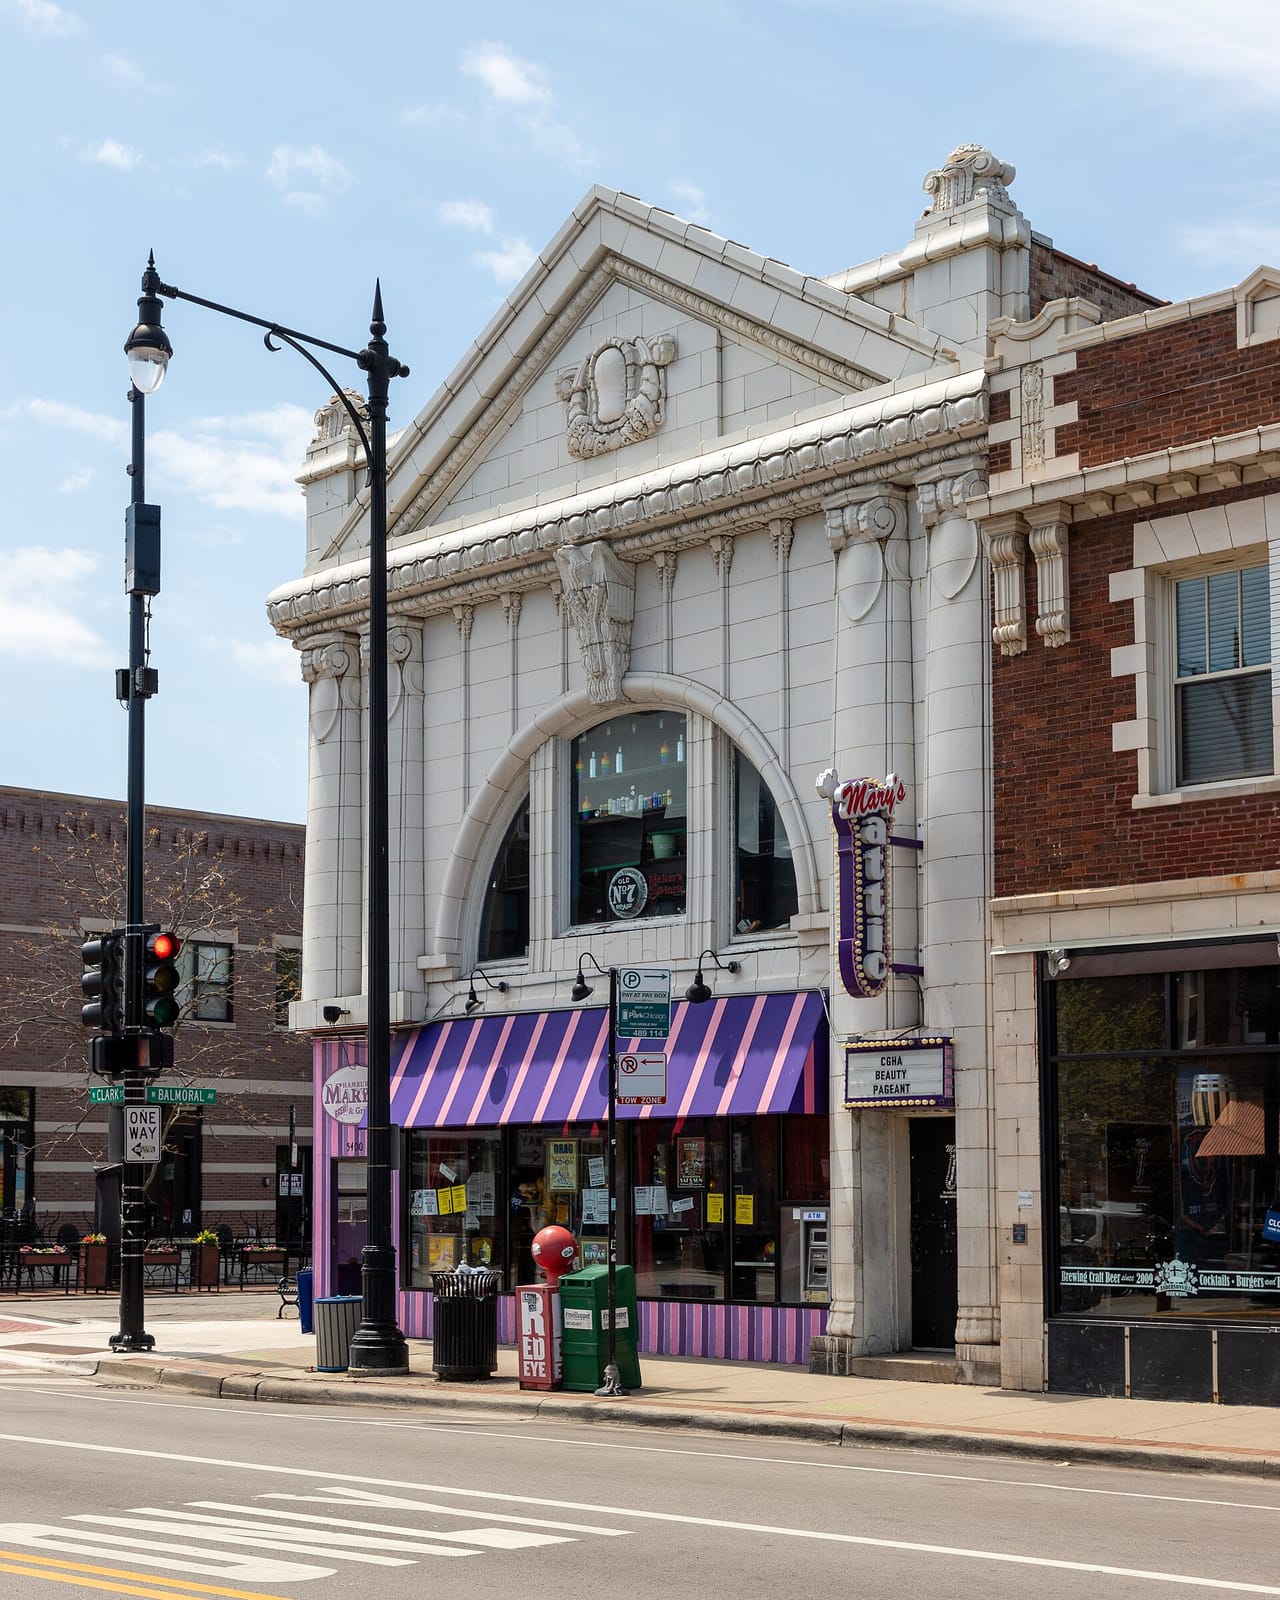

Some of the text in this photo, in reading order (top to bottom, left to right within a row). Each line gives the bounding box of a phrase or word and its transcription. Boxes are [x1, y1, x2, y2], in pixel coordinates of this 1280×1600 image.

[843, 775, 906, 815] Mary's
[618, 877, 630, 885] OLD
[860, 815, 888, 981] attic
[628, 1011, 667, 1021] ParkChicago
[632, 1029, 647, 1037] 489
[881, 1056, 903, 1066] CGHA
[875, 1070, 907, 1080] BEAUTY
[342, 1080, 368, 1088] HAMBUR
[873, 1084, 911, 1095] PAGEANT
[96, 1088, 119, 1101] CLARK
[158, 1089, 205, 1102] BALMORAL
[324, 1082, 368, 1105] MARY
[620, 1096, 663, 1104] TOW ZONE
[129, 1111, 156, 1124] ONE
[128, 1126, 157, 1140] WAY
[346, 1142, 364, 1152] 5400
[553, 1143, 574, 1154] DRAG
[584, 1250, 605, 1259] DIVAS
[1061, 1270, 1088, 1284] Brewing
[1088, 1271, 1105, 1283] Craft
[1105, 1271, 1121, 1284] Beer
[1136, 1272, 1154, 1285] 2009
[1199, 1274, 1231, 1287] Cocktails
[1236, 1274, 1265, 1289] Burgers
[523, 1361, 546, 1377] EYE
